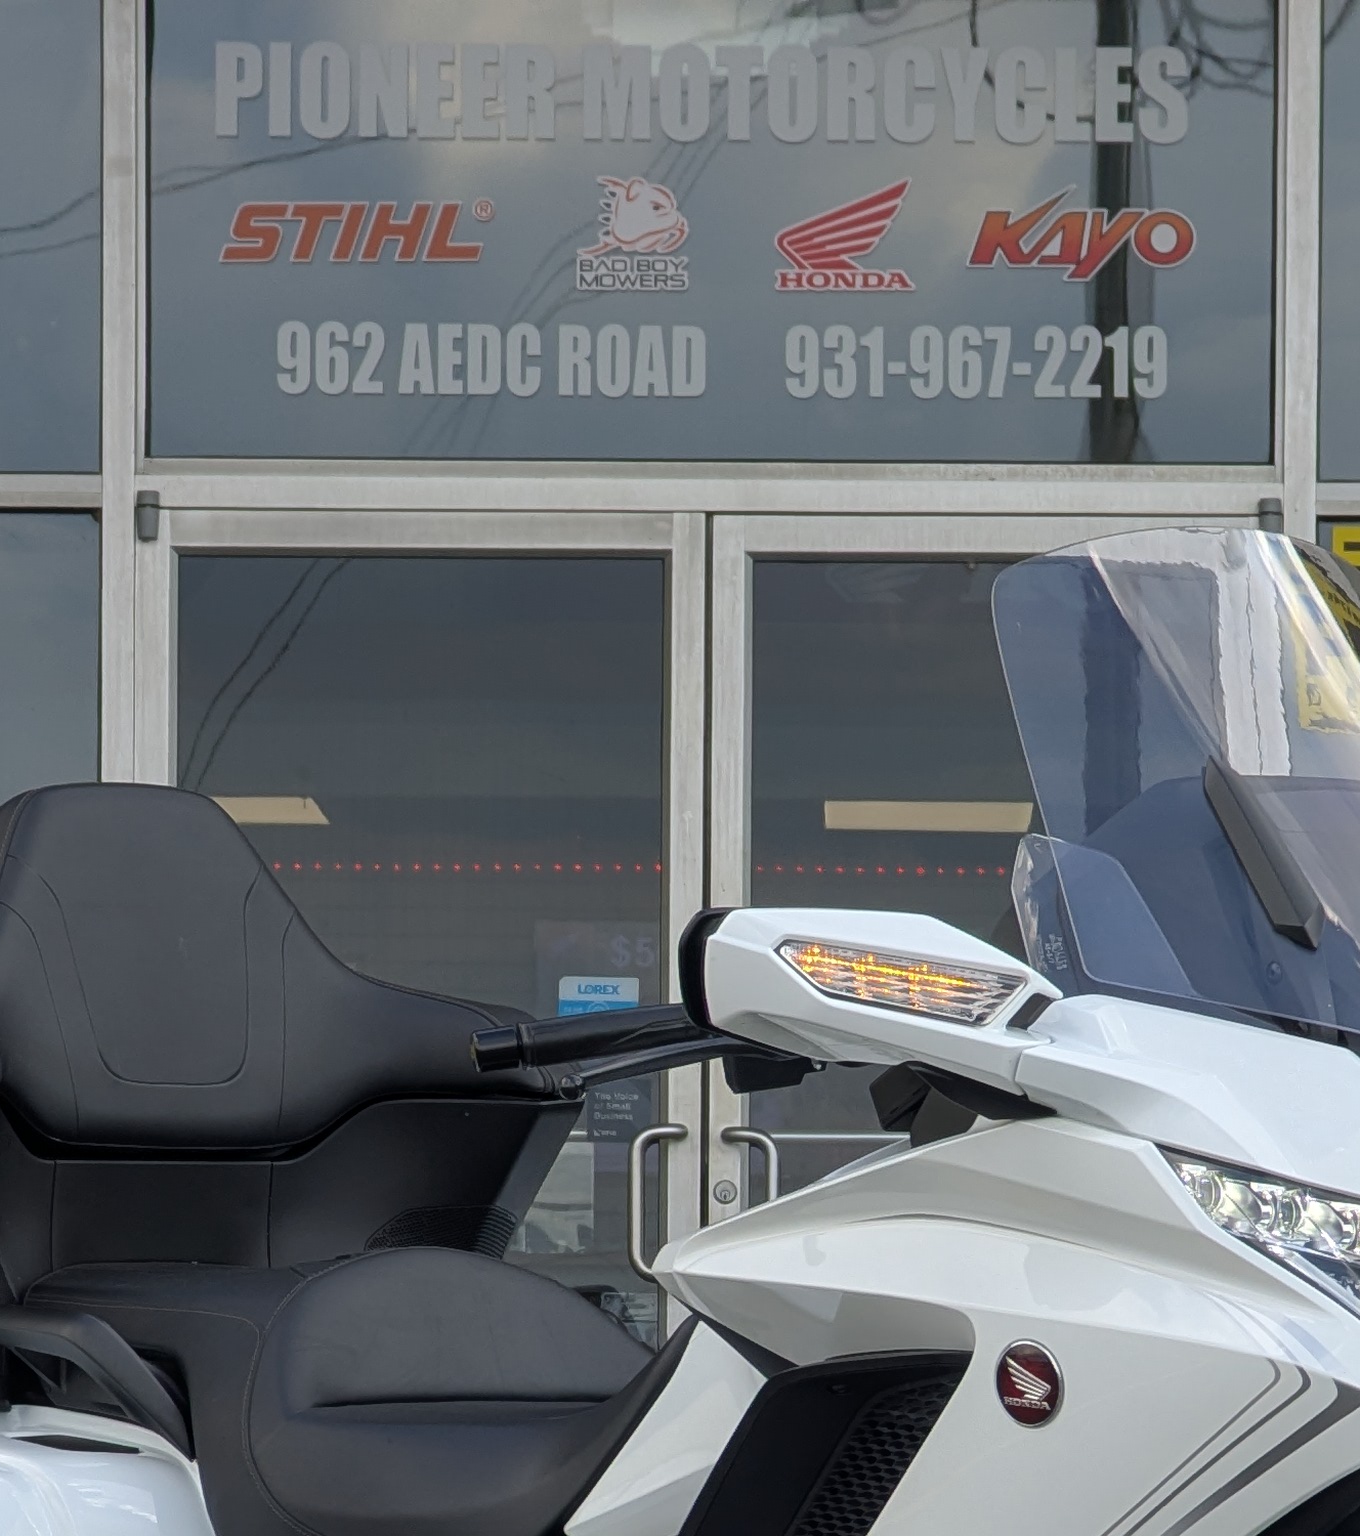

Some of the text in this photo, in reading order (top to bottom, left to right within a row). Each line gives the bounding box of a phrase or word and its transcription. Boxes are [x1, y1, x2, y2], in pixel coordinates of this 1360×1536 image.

[215, 41, 1189, 145] PIONEER MOTORCYCLES
[967, 184, 1195, 282] KAYO
[578, 257, 687, 274] BAD BOY
[578, 273, 687, 289] MOWERS
[776, 269, 915, 291] HONDA
[276, 320, 707, 398] 962 AEDC ROAD
[784, 324, 1168, 399] 931-967-2219
[577, 984, 621, 995] LOREX
[1003, 1396, 1052, 1411] HONDA
